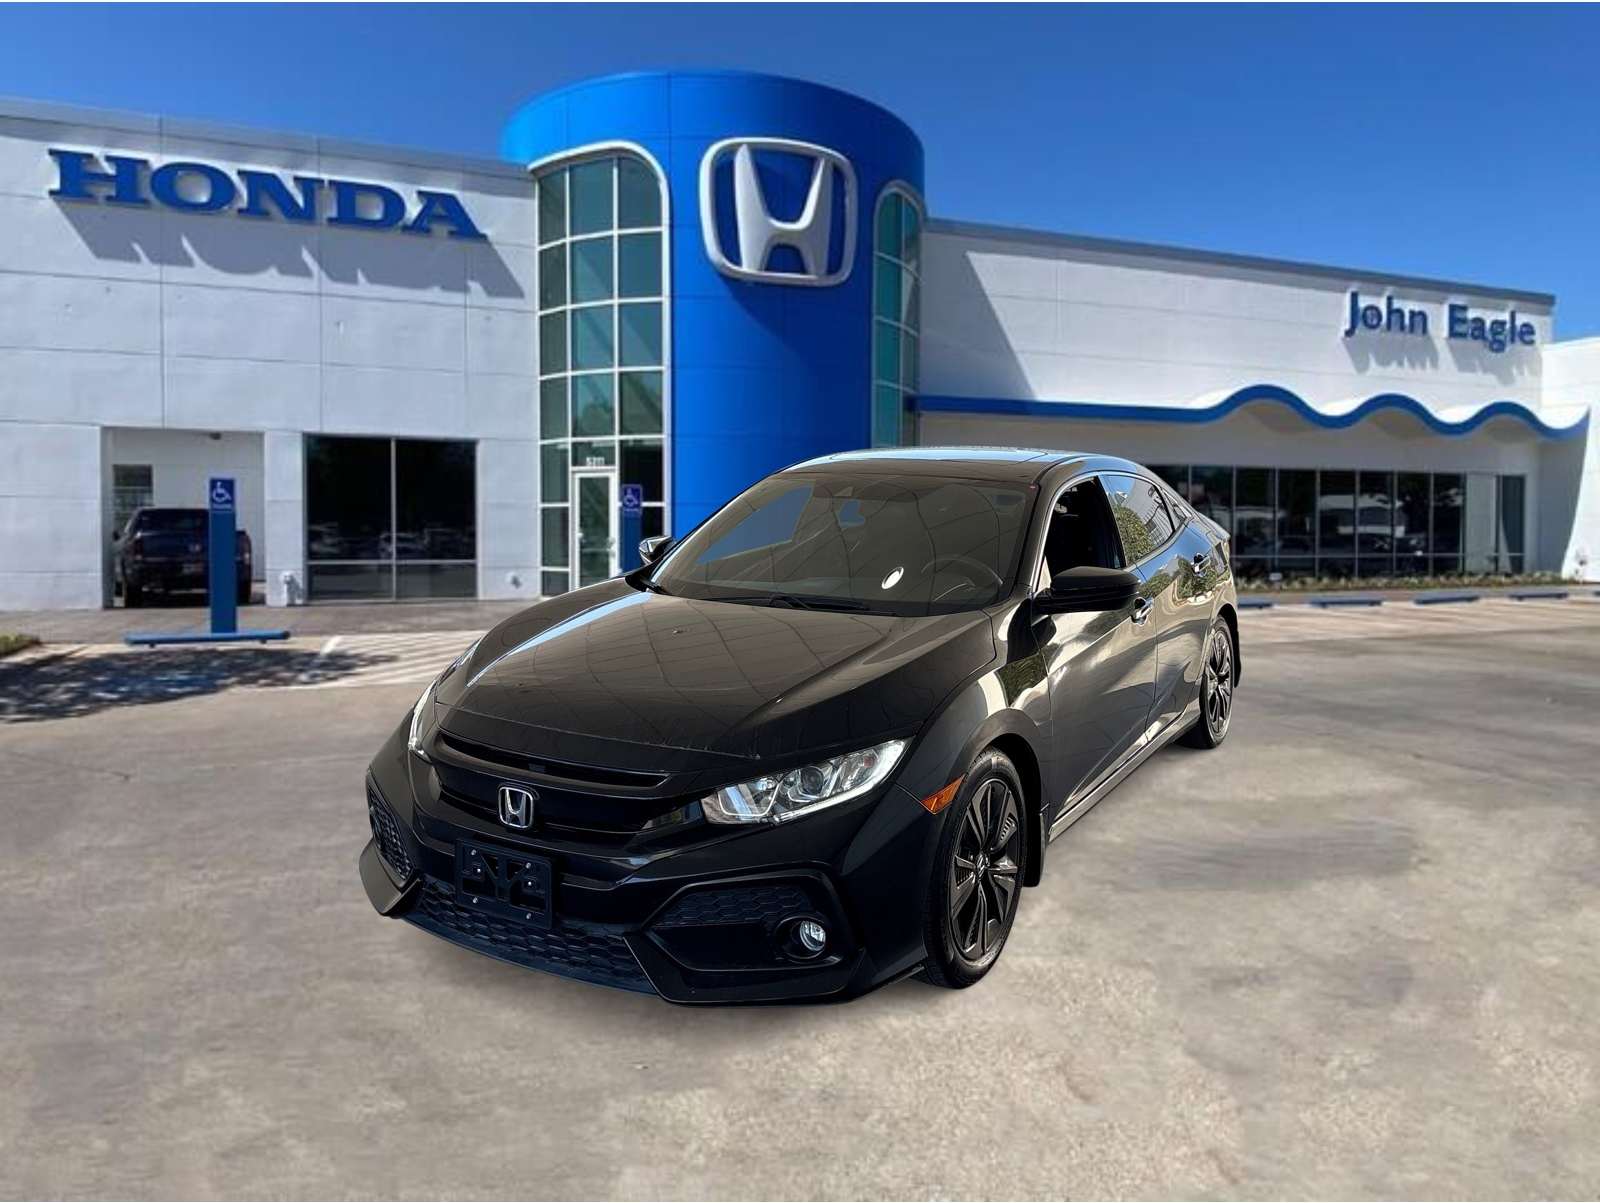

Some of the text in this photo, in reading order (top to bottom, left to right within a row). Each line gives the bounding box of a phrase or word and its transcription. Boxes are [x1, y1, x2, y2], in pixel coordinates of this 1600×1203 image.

[48, 148, 488, 240] HONDA
[1344, 291, 1536, 353] John Eagle
